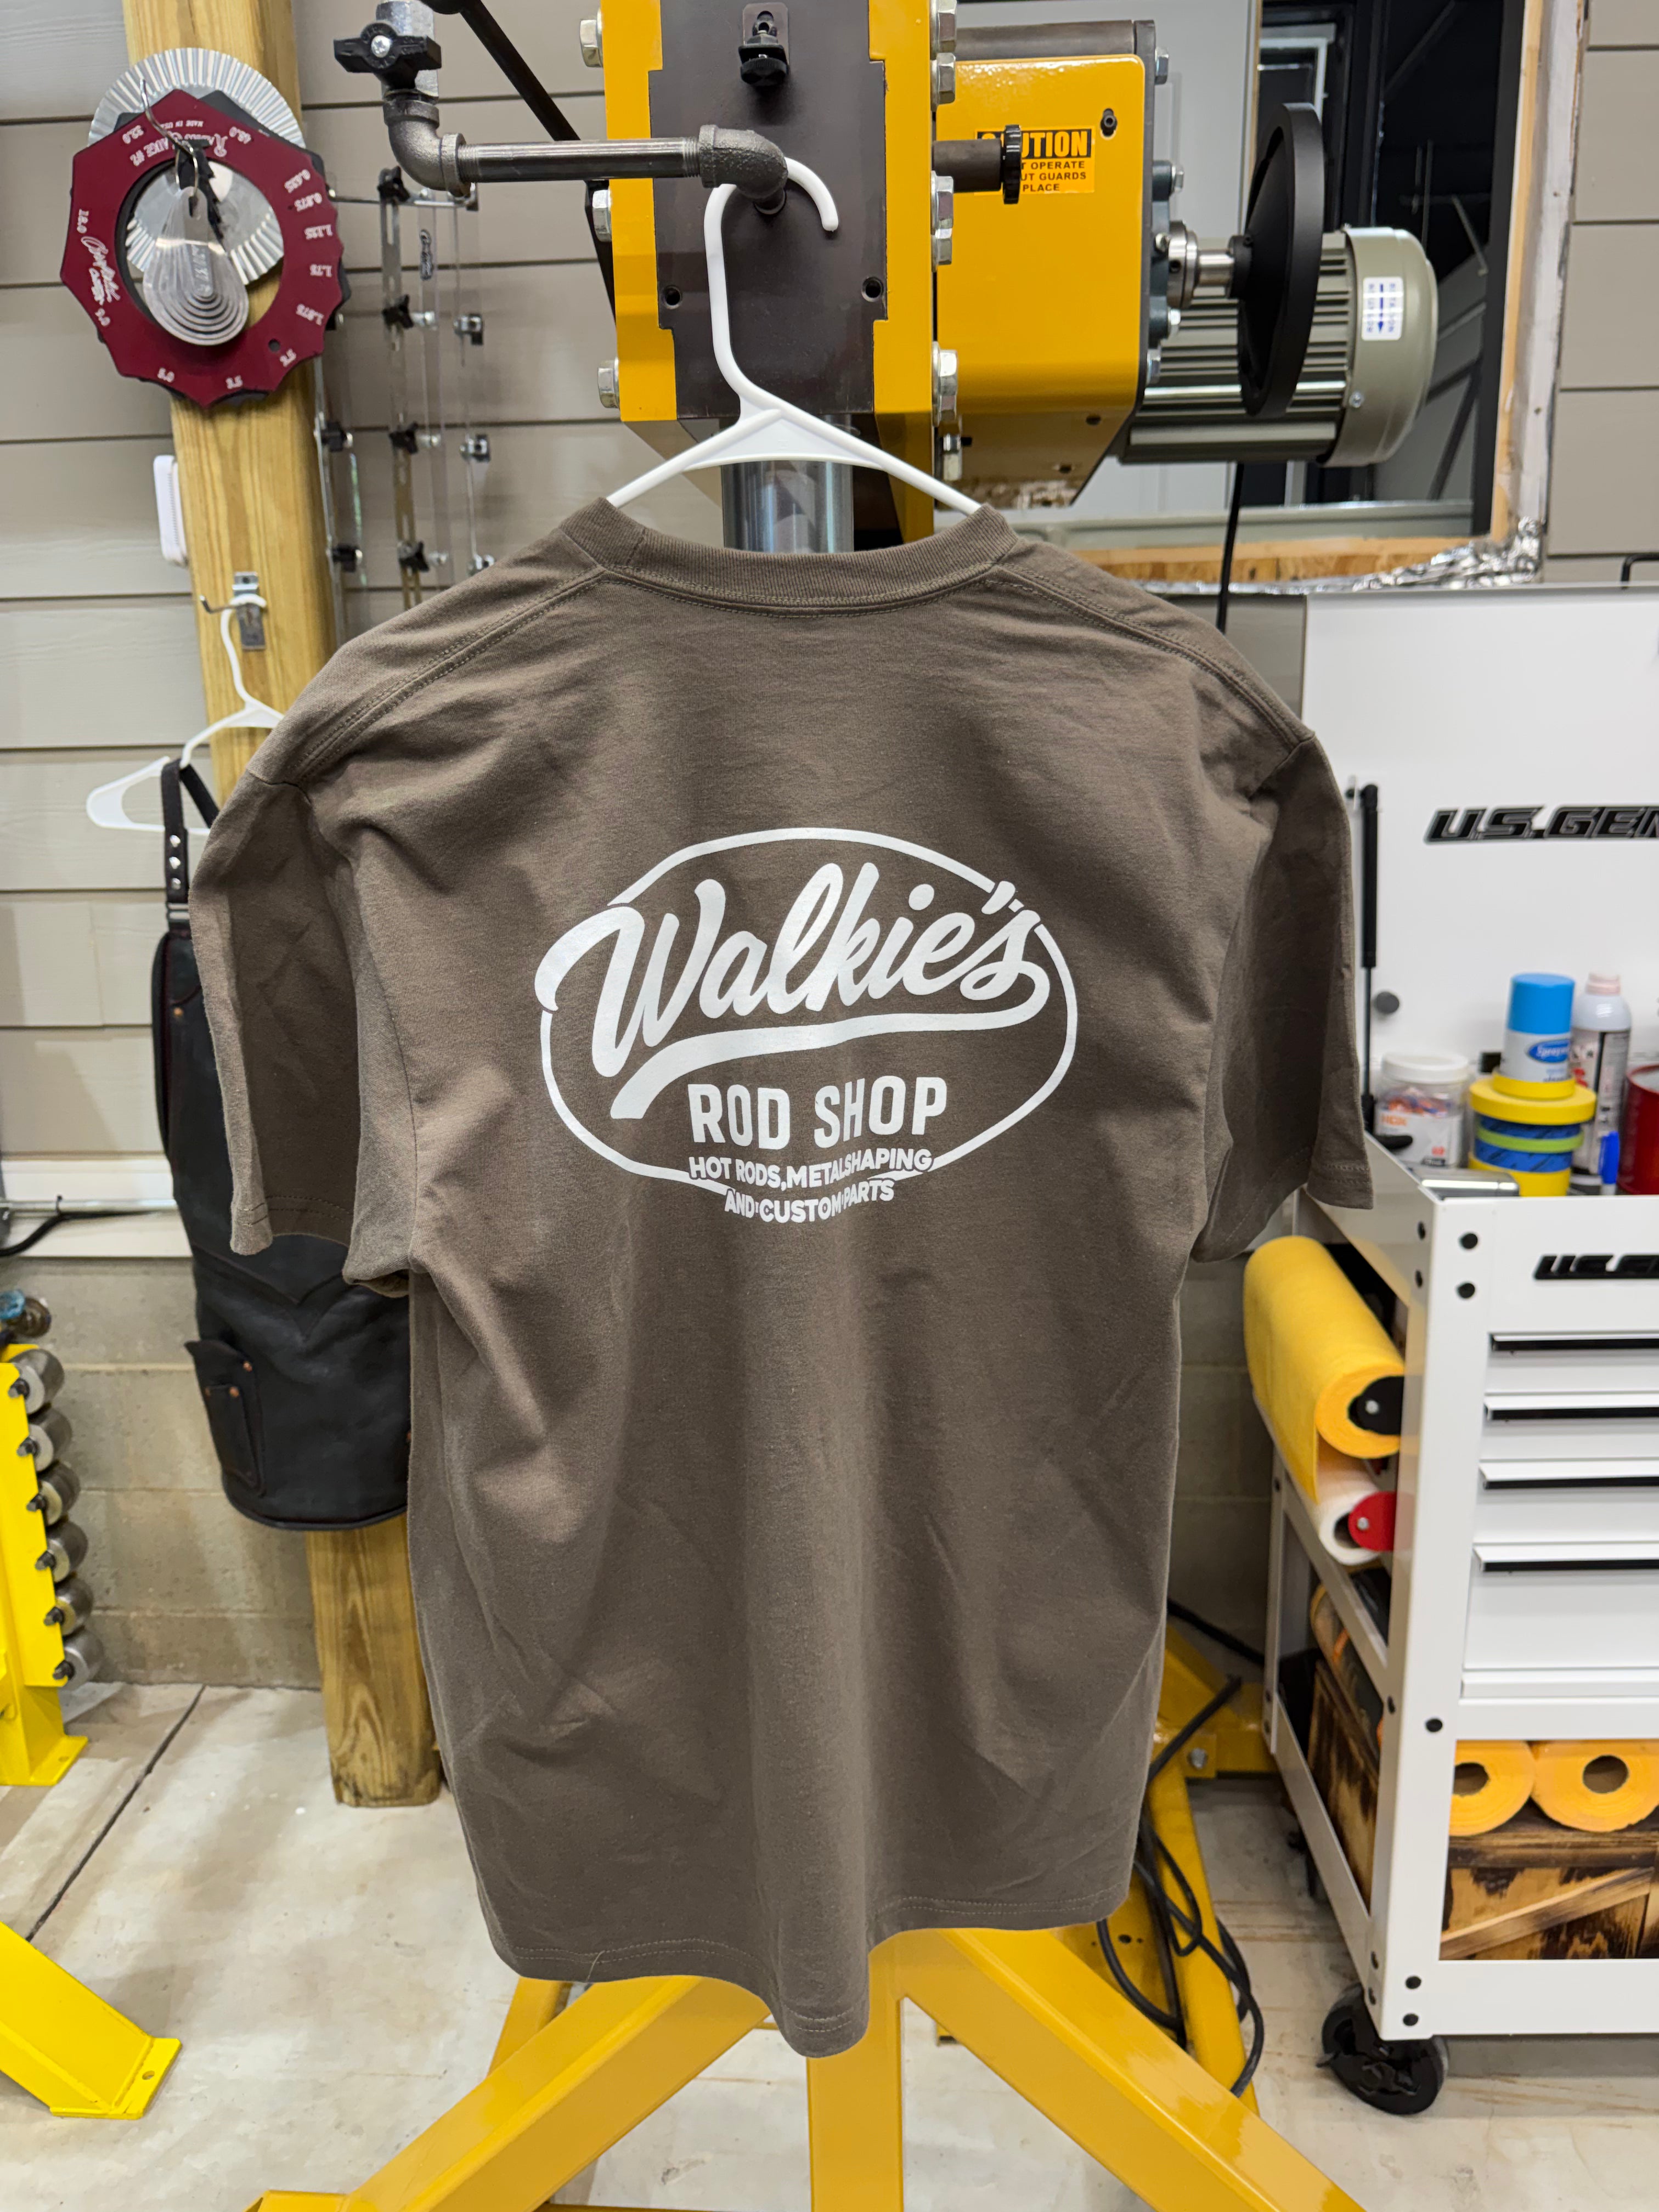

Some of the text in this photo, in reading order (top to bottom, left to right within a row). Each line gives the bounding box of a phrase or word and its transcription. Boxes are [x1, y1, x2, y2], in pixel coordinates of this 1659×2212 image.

[1031, 160, 1085, 170] OPERATE
[1039, 172, 1087, 181] GUARDS
[1023, 183, 1060, 192] PLACE
[535, 863, 1042, 1078] Walkie's
[687, 1076, 947, 1150] ROD SHOP
[689, 1156, 732, 1180] HOT
[724, 1180, 895, 1223] AND CUSTOM PARTS
